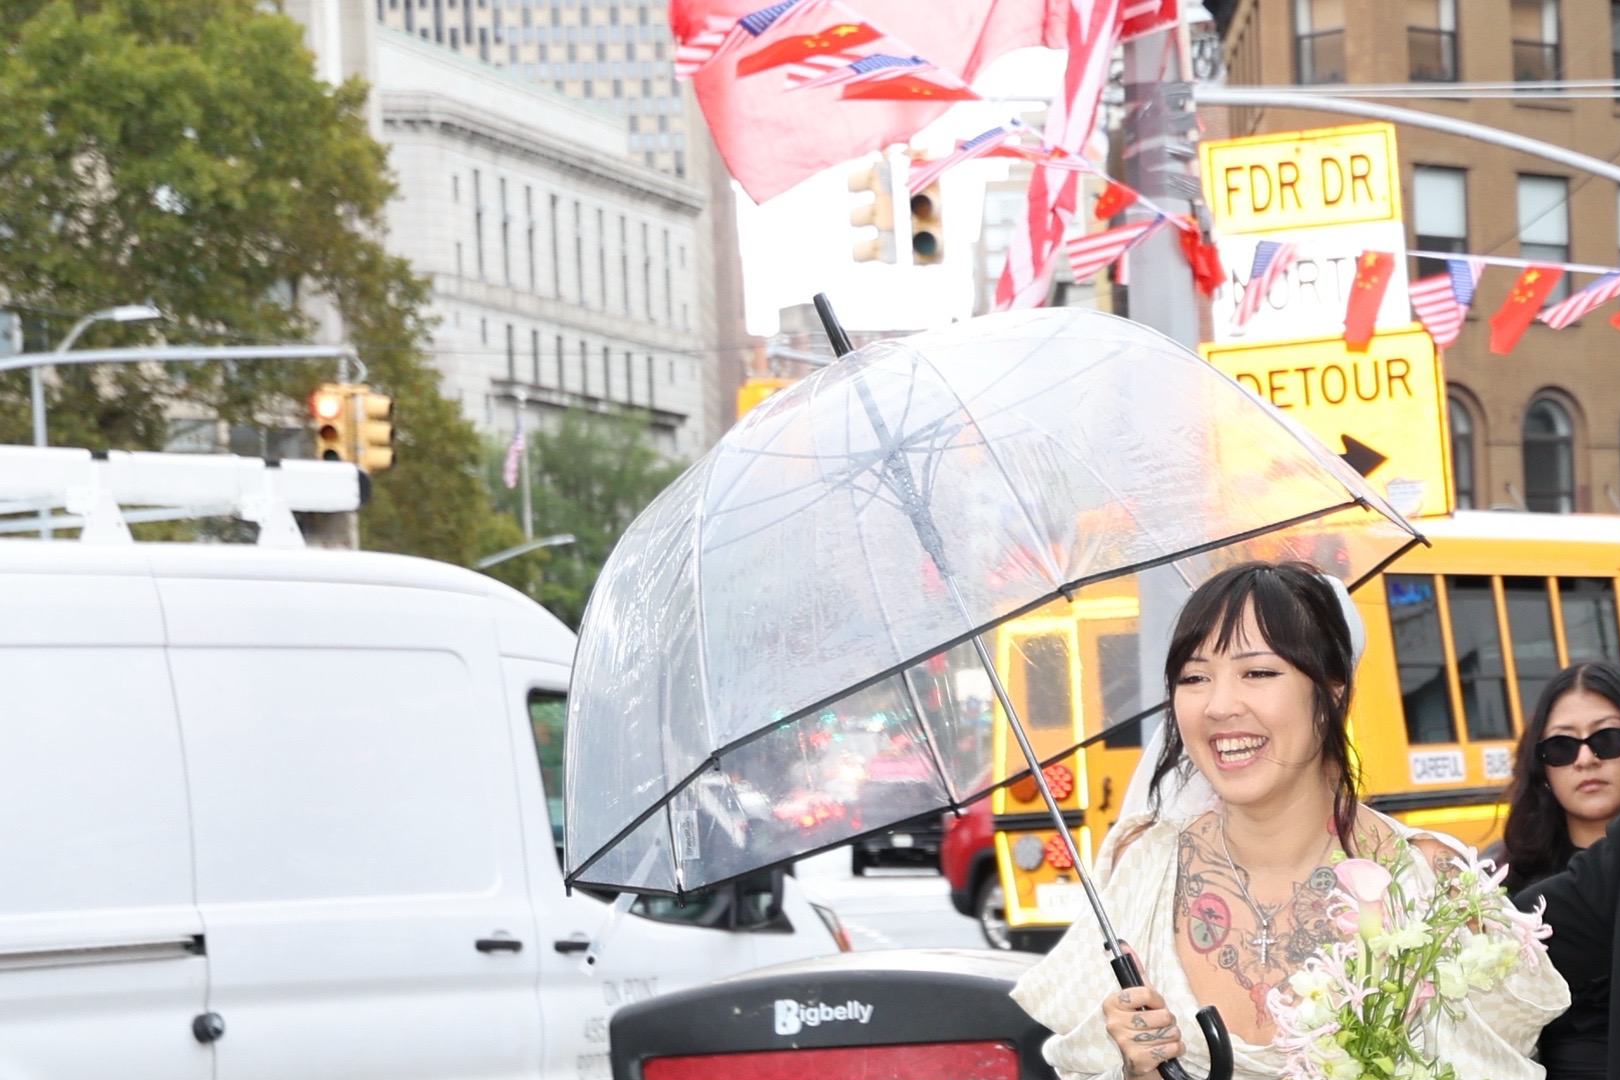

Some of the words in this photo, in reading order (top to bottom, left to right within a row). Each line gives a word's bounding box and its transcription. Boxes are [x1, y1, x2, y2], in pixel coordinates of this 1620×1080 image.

[1224, 161, 1302, 216] FDR
[1320, 153, 1375, 207] DR
[1231, 256, 1366, 312] NORT
[1235, 358, 1413, 408] DETOUR
[1413, 754, 1463, 780] CAREFUL
[774, 998, 874, 1035] Bigbelly
